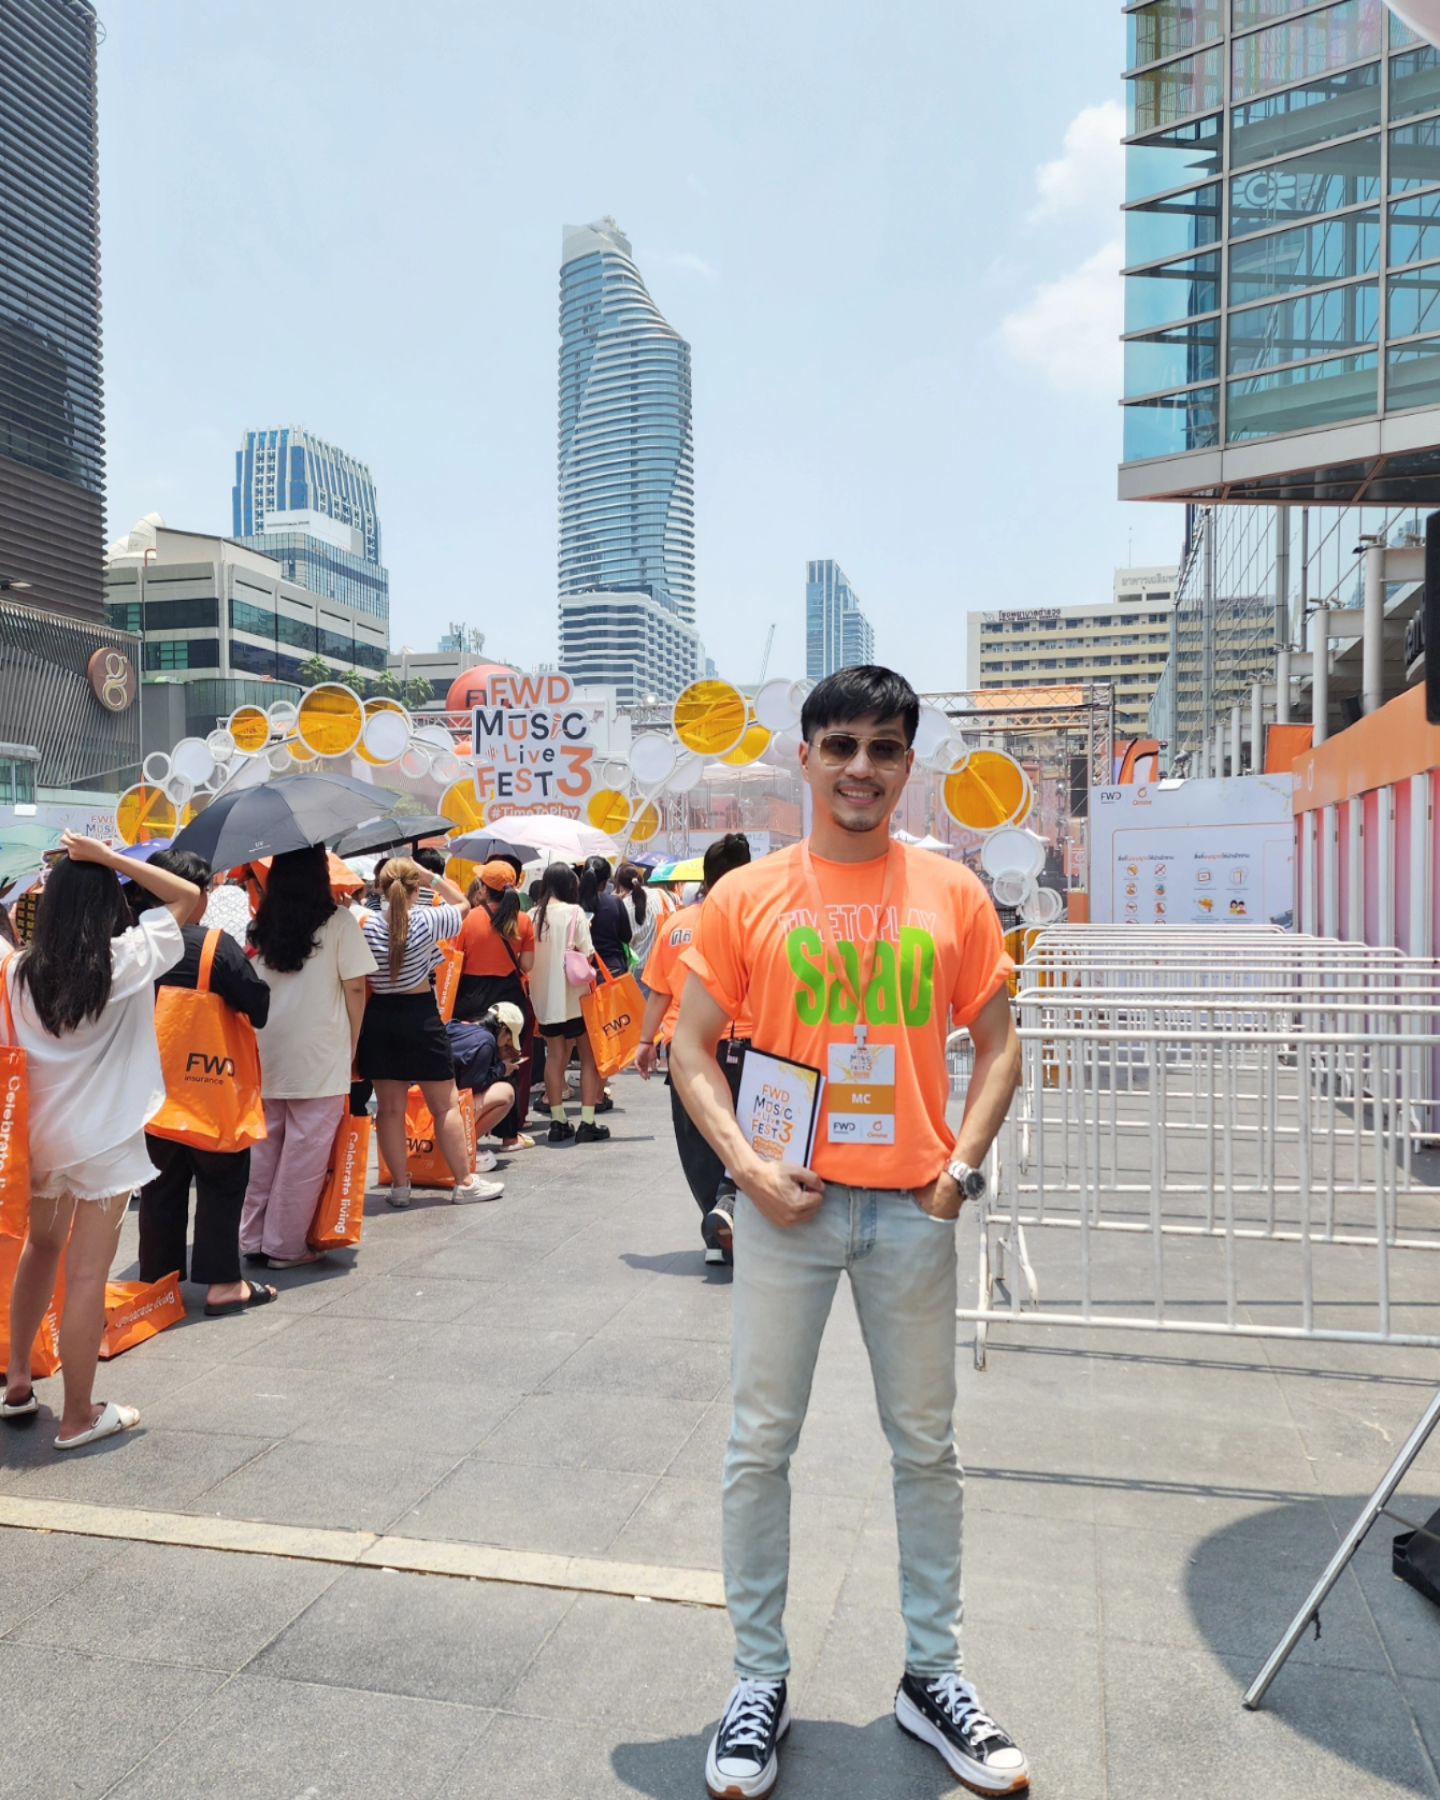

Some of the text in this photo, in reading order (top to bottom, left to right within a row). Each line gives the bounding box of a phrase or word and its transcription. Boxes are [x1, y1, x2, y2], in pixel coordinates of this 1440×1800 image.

[491, 676, 570, 705] FWD
[504, 744, 555, 764] Live
[477, 745, 594, 798] FEST 3
[1101, 792, 1121, 801] FWD
[602, 1014, 631, 1037] FWD
[186, 1052, 236, 1078] FWD
[184, 1074, 224, 1086] insurance
[762, 1083, 790, 1103] FWD
[851, 1093, 872, 1105] MC
[752, 1119, 795, 1143] FEST 3
[833, 1121, 856, 1132] FWD
[405, 1138, 434, 1154] WD
[334, 1131, 360, 1234] Celebrate living
